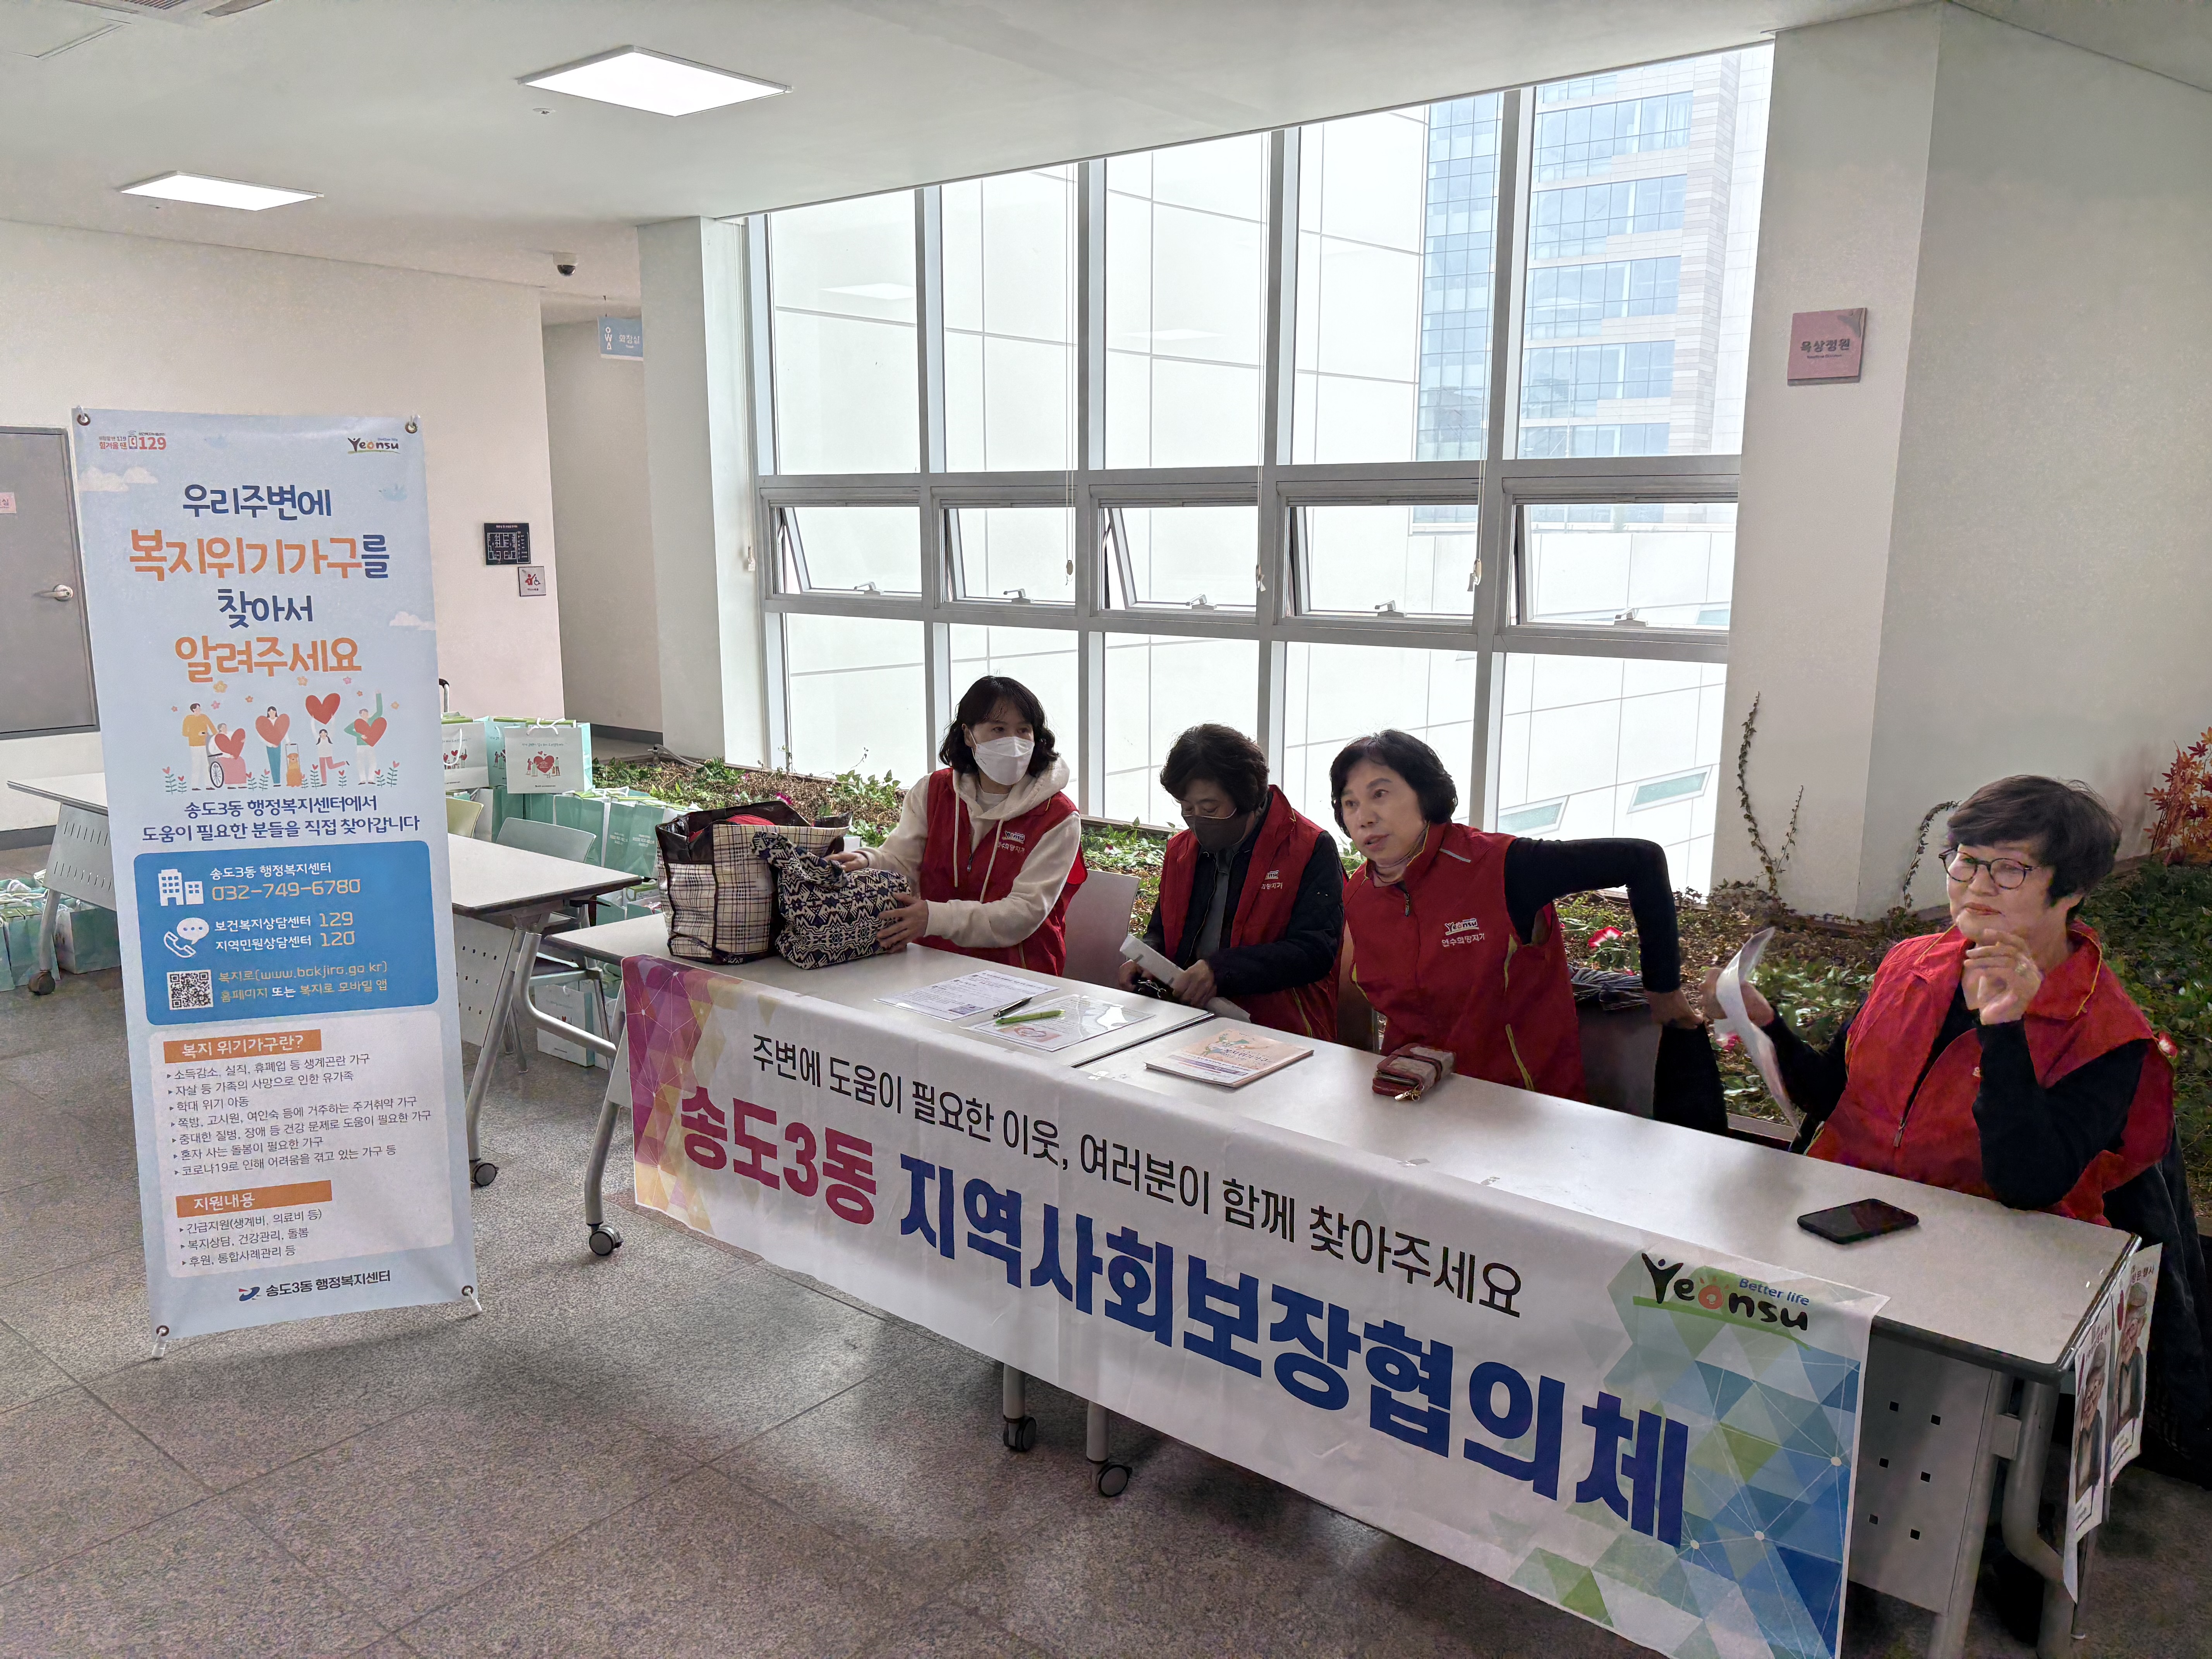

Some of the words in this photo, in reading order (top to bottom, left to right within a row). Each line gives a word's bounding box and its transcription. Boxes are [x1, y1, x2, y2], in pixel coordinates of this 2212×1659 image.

[1801, 338, 1850, 352] 옥상정원
[139, 437, 166, 450] 129
[347, 438, 399, 452] Yeonsu
[183, 484, 331, 520] 우리주변에
[129, 528, 390, 582] 복지위기가구를
[218, 589, 313, 629] 찾아서
[174, 635, 362, 682] 알려주세요
[184, 800, 244, 819] 송도3동
[247, 795, 377, 817] 행정복지센터에서
[143, 823, 192, 843] 도움이
[197, 823, 248, 842] 필요한
[251, 819, 300, 839] 분들을
[305, 819, 337, 836] 직접
[340, 816, 420, 834] 찾아갑니다
[210, 866, 256, 881] 송도3동
[260, 862, 331, 877] 행정복지센터
[211, 879, 361, 901] 032-749-6780
[215, 915, 311, 932] 보건복지상담센터
[319, 912, 353, 927] 129
[1445, 921, 1477, 933] Yeonsu
[216, 935, 311, 952] 지역민원상담센터
[320, 931, 355, 946] 120
[1442, 933, 1485, 947] 연수희망지기
[221, 988, 268, 1003] 홈페이지
[272, 986, 296, 998] 또는
[300, 983, 335, 995] 복지로
[338, 980, 373, 992] 모바일
[376, 979, 387, 991] 앱
[182, 1042, 212, 1058] 복지
[217, 1035, 304, 1055] 위기가구란?
[174, 1067, 221, 1080] 소득감소,
[254, 1061, 286, 1073] 휴폐업
[290, 1060, 300, 1070] 등
[304, 1055, 346, 1069] 생계곤란
[350, 1053, 370, 1065] 가구
[175, 1084, 197, 1096] 자살
[201, 1084, 211, 1094] 등
[216, 1080, 247, 1092] 가족의
[252, 1076, 295, 1089] 사망으로
[298, 1074, 319, 1085] 인한
[323, 1071, 354, 1083] 유가족
[177, 1100, 198, 1112] 학대
[203, 1099, 223, 1110] 위기
[228, 1096, 249, 1108] 아동
[178, 1117, 203, 1128] 쪽방,
[207, 1113, 243, 1125] 고시원,
[247, 1110, 279, 1122] 여인숙
[282, 1107, 304, 1119] 등에
[308, 1103, 349, 1116] 거주하는
[353, 1098, 394, 1112] 주거취약
[397, 1096, 417, 1107] 가구
[179, 1132, 211, 1145] 중대한
[245, 1127, 266, 1138] 장애
[270, 1125, 280, 1136] 등
[284, 1123, 304, 1134] 건강
[308, 1120, 340, 1132] 문제로
[343, 1115, 374, 1128] 도움이
[378, 1112, 407, 1125] 필요한
[412, 1110, 431, 1121] 가구
[181, 1148, 202, 1161] 혼자
[206, 1147, 227, 1158] 사는
[231, 1142, 263, 1156] 돌봄이
[267, 1138, 299, 1152] 필요한
[302, 1137, 323, 1148] 가구
[182, 1162, 239, 1176] 코로나19로
[243, 1159, 264, 1170] 인해
[268, 1153, 310, 1167] 어려움을
[314, 1151, 335, 1162] 겪고
[338, 1149, 359, 1160] 있는
[362, 1146, 383, 1158] 가구
[386, 1145, 397, 1156] 등
[752, 1034, 821, 1088] 주변에
[829, 1058, 902, 1113] 도움이
[912, 1080, 994, 1143] 필요한
[1003, 1110, 1069, 1170] 이웃,
[1080, 1134, 1210, 1215] 여러분이
[1223, 1178, 1295, 1242] 함께
[1310, 1205, 1522, 1318] 찾아주세요
[194, 1192, 255, 1211] 지원내용
[273, 1211, 304, 1224] 의료비
[307, 1208, 322, 1220] 등)
[188, 1236, 234, 1250] 복지상담,
[239, 1231, 284, 1245] 건강관리,
[287, 1227, 309, 1239] 돌봄
[189, 1255, 214, 1267] 후원,
[218, 1247, 281, 1264] 통합사례관리
[285, 1245, 296, 1256] 등
[265, 1281, 313, 1297] 송도3동
[316, 1270, 391, 1291] 행정복지센터
[1642, 1252, 1808, 1331] Yeonsu
[1739, 1277, 1784, 1300] Better
[1786, 1292, 1810, 1306] life
[681, 1085, 877, 1225] 송도3동
[900, 1153, 1688, 1548] 지역사회보장협의체
